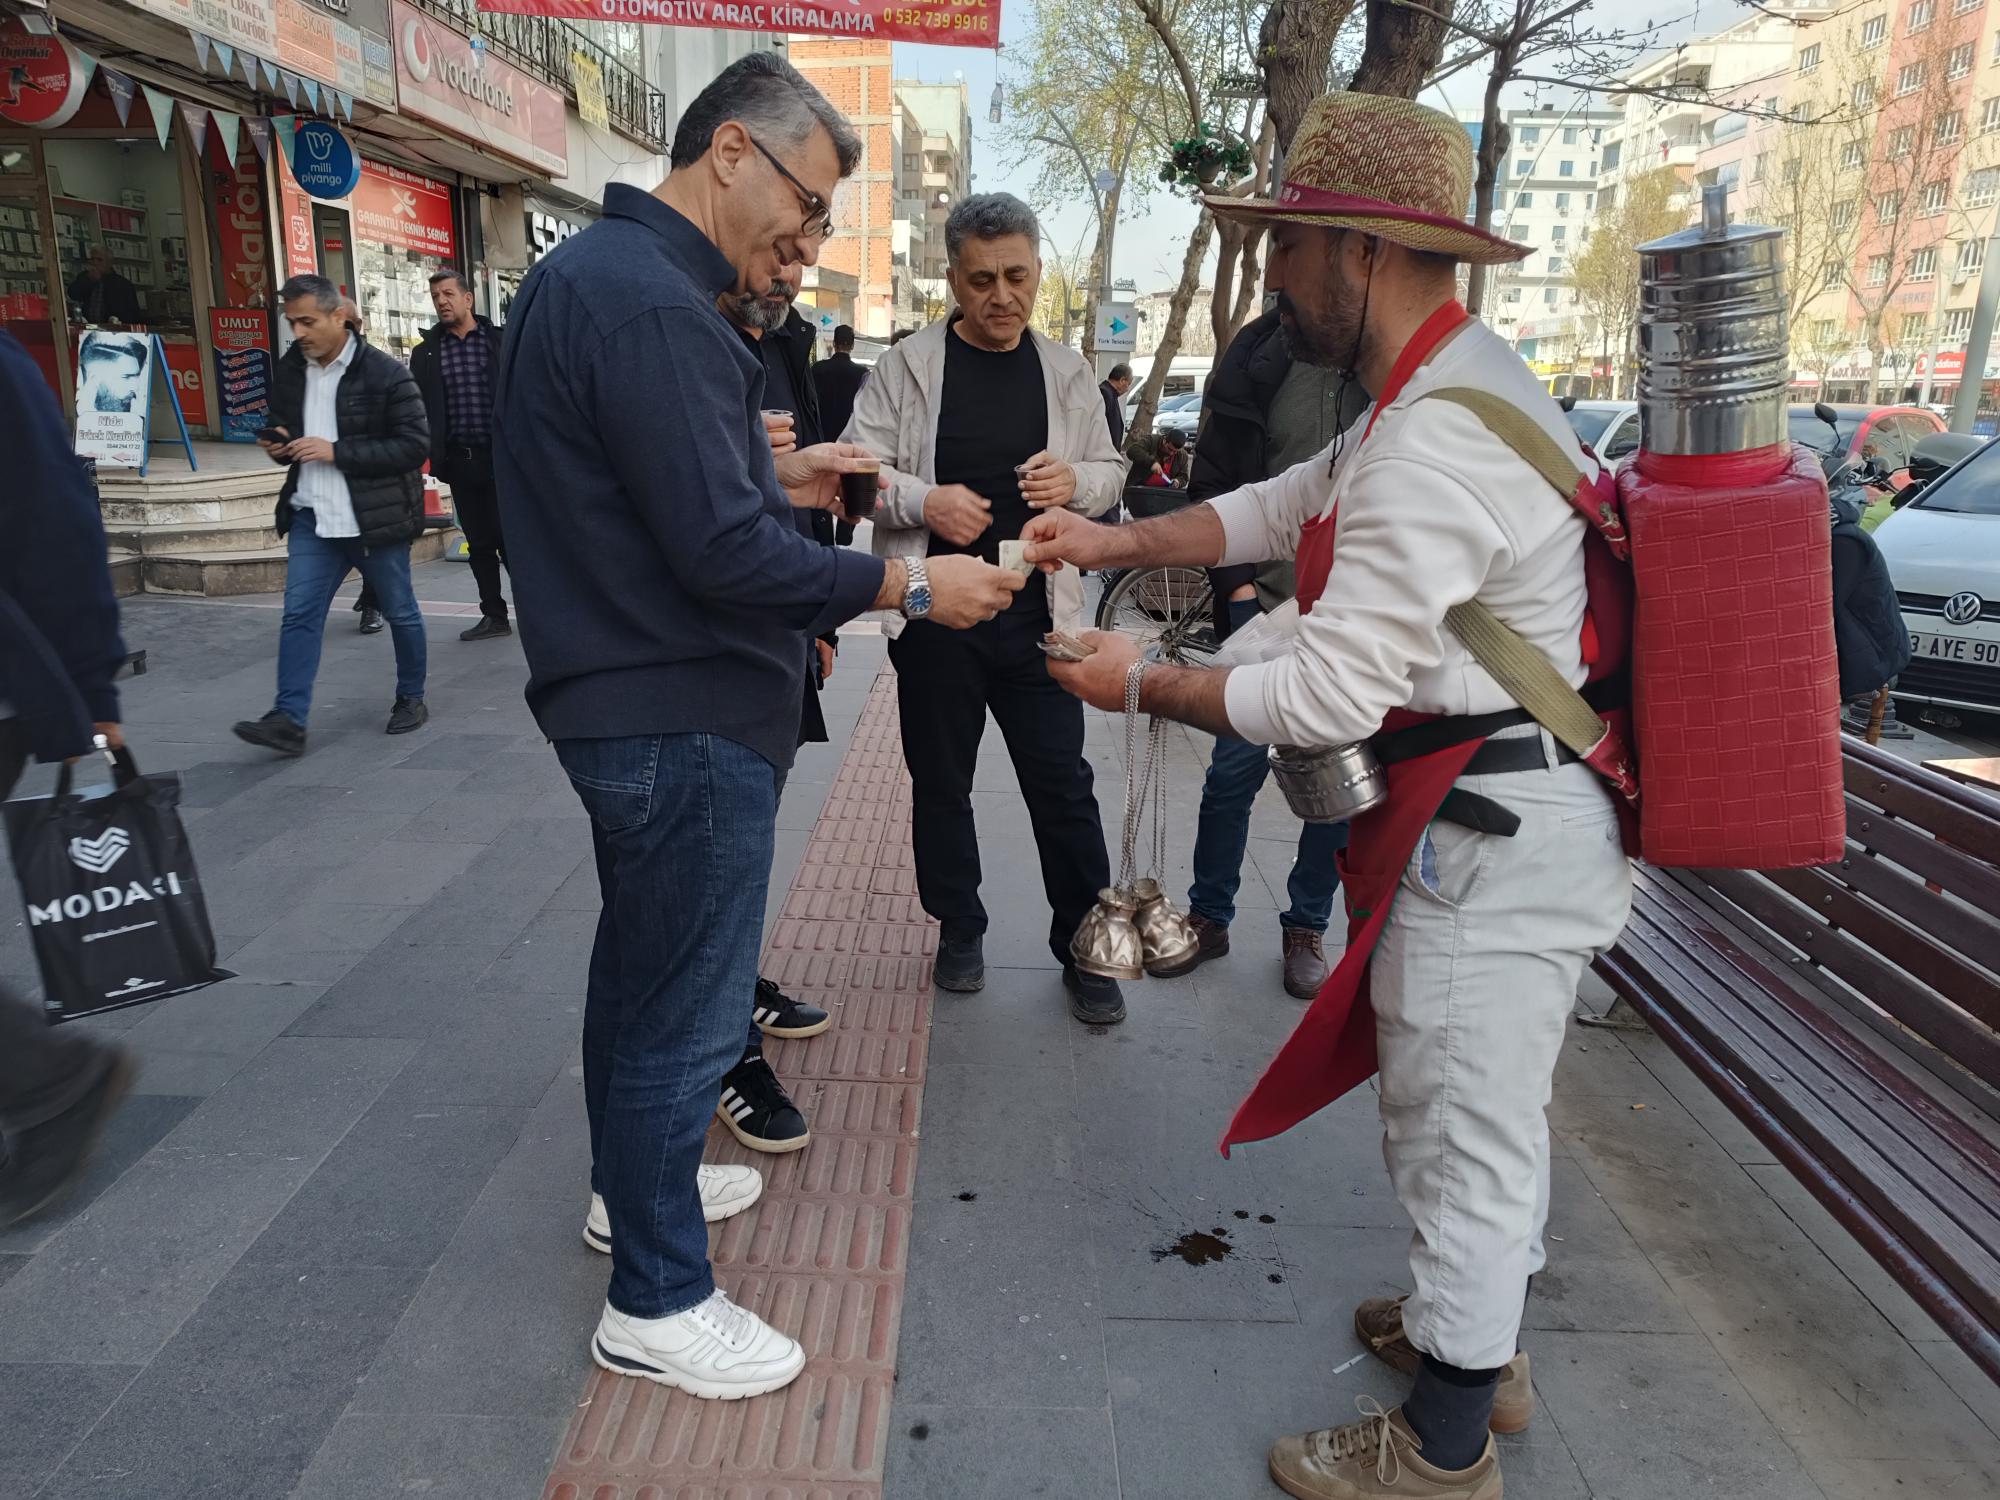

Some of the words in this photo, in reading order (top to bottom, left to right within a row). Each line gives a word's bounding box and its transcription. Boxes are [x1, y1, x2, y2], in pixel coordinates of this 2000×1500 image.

[711, 3, 765, 28] ARAÇ
[771, 3, 875, 32] KİRALAMA
[883, 7, 892, 22] 0
[896, 8, 921, 26] 532
[925, 11, 950, 28] 739
[954, 13, 988, 31] 9916
[435, 52, 514, 118] vodafone
[310, 163, 332, 173] milli
[301, 174, 342, 187] piyango
[230, 124, 269, 306] odafone
[400, 219, 426, 238] TEKNİK
[426, 225, 450, 244] SERVİS
[218, 317, 260, 329] UMUT
[98, 415, 124, 427] Nida
[78, 429, 105, 441] Erkek
[1929, 637, 1967, 660] AYE
